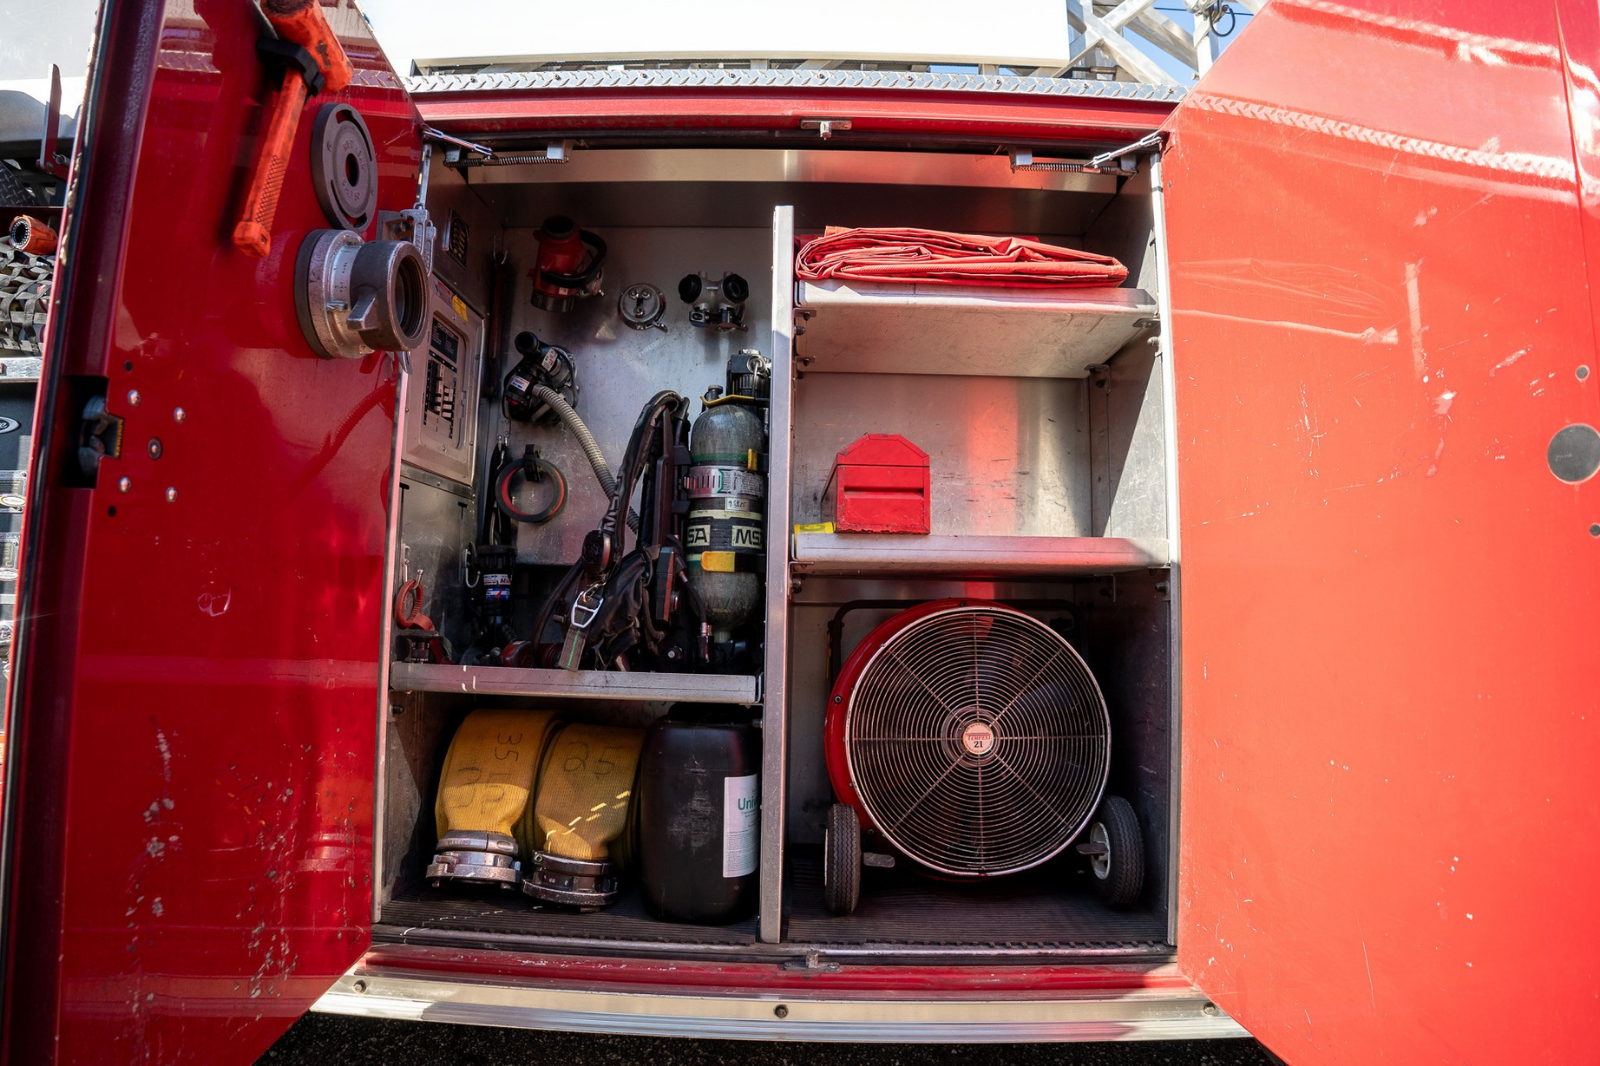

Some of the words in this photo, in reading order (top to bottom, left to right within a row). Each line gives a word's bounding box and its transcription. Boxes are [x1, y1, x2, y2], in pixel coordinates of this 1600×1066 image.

[687, 527, 708, 543] SA
[735, 528, 761, 545] MS
[494, 733, 524, 761] 35
[973, 740, 983, 748] 21
[738, 796, 757, 811] Uni
